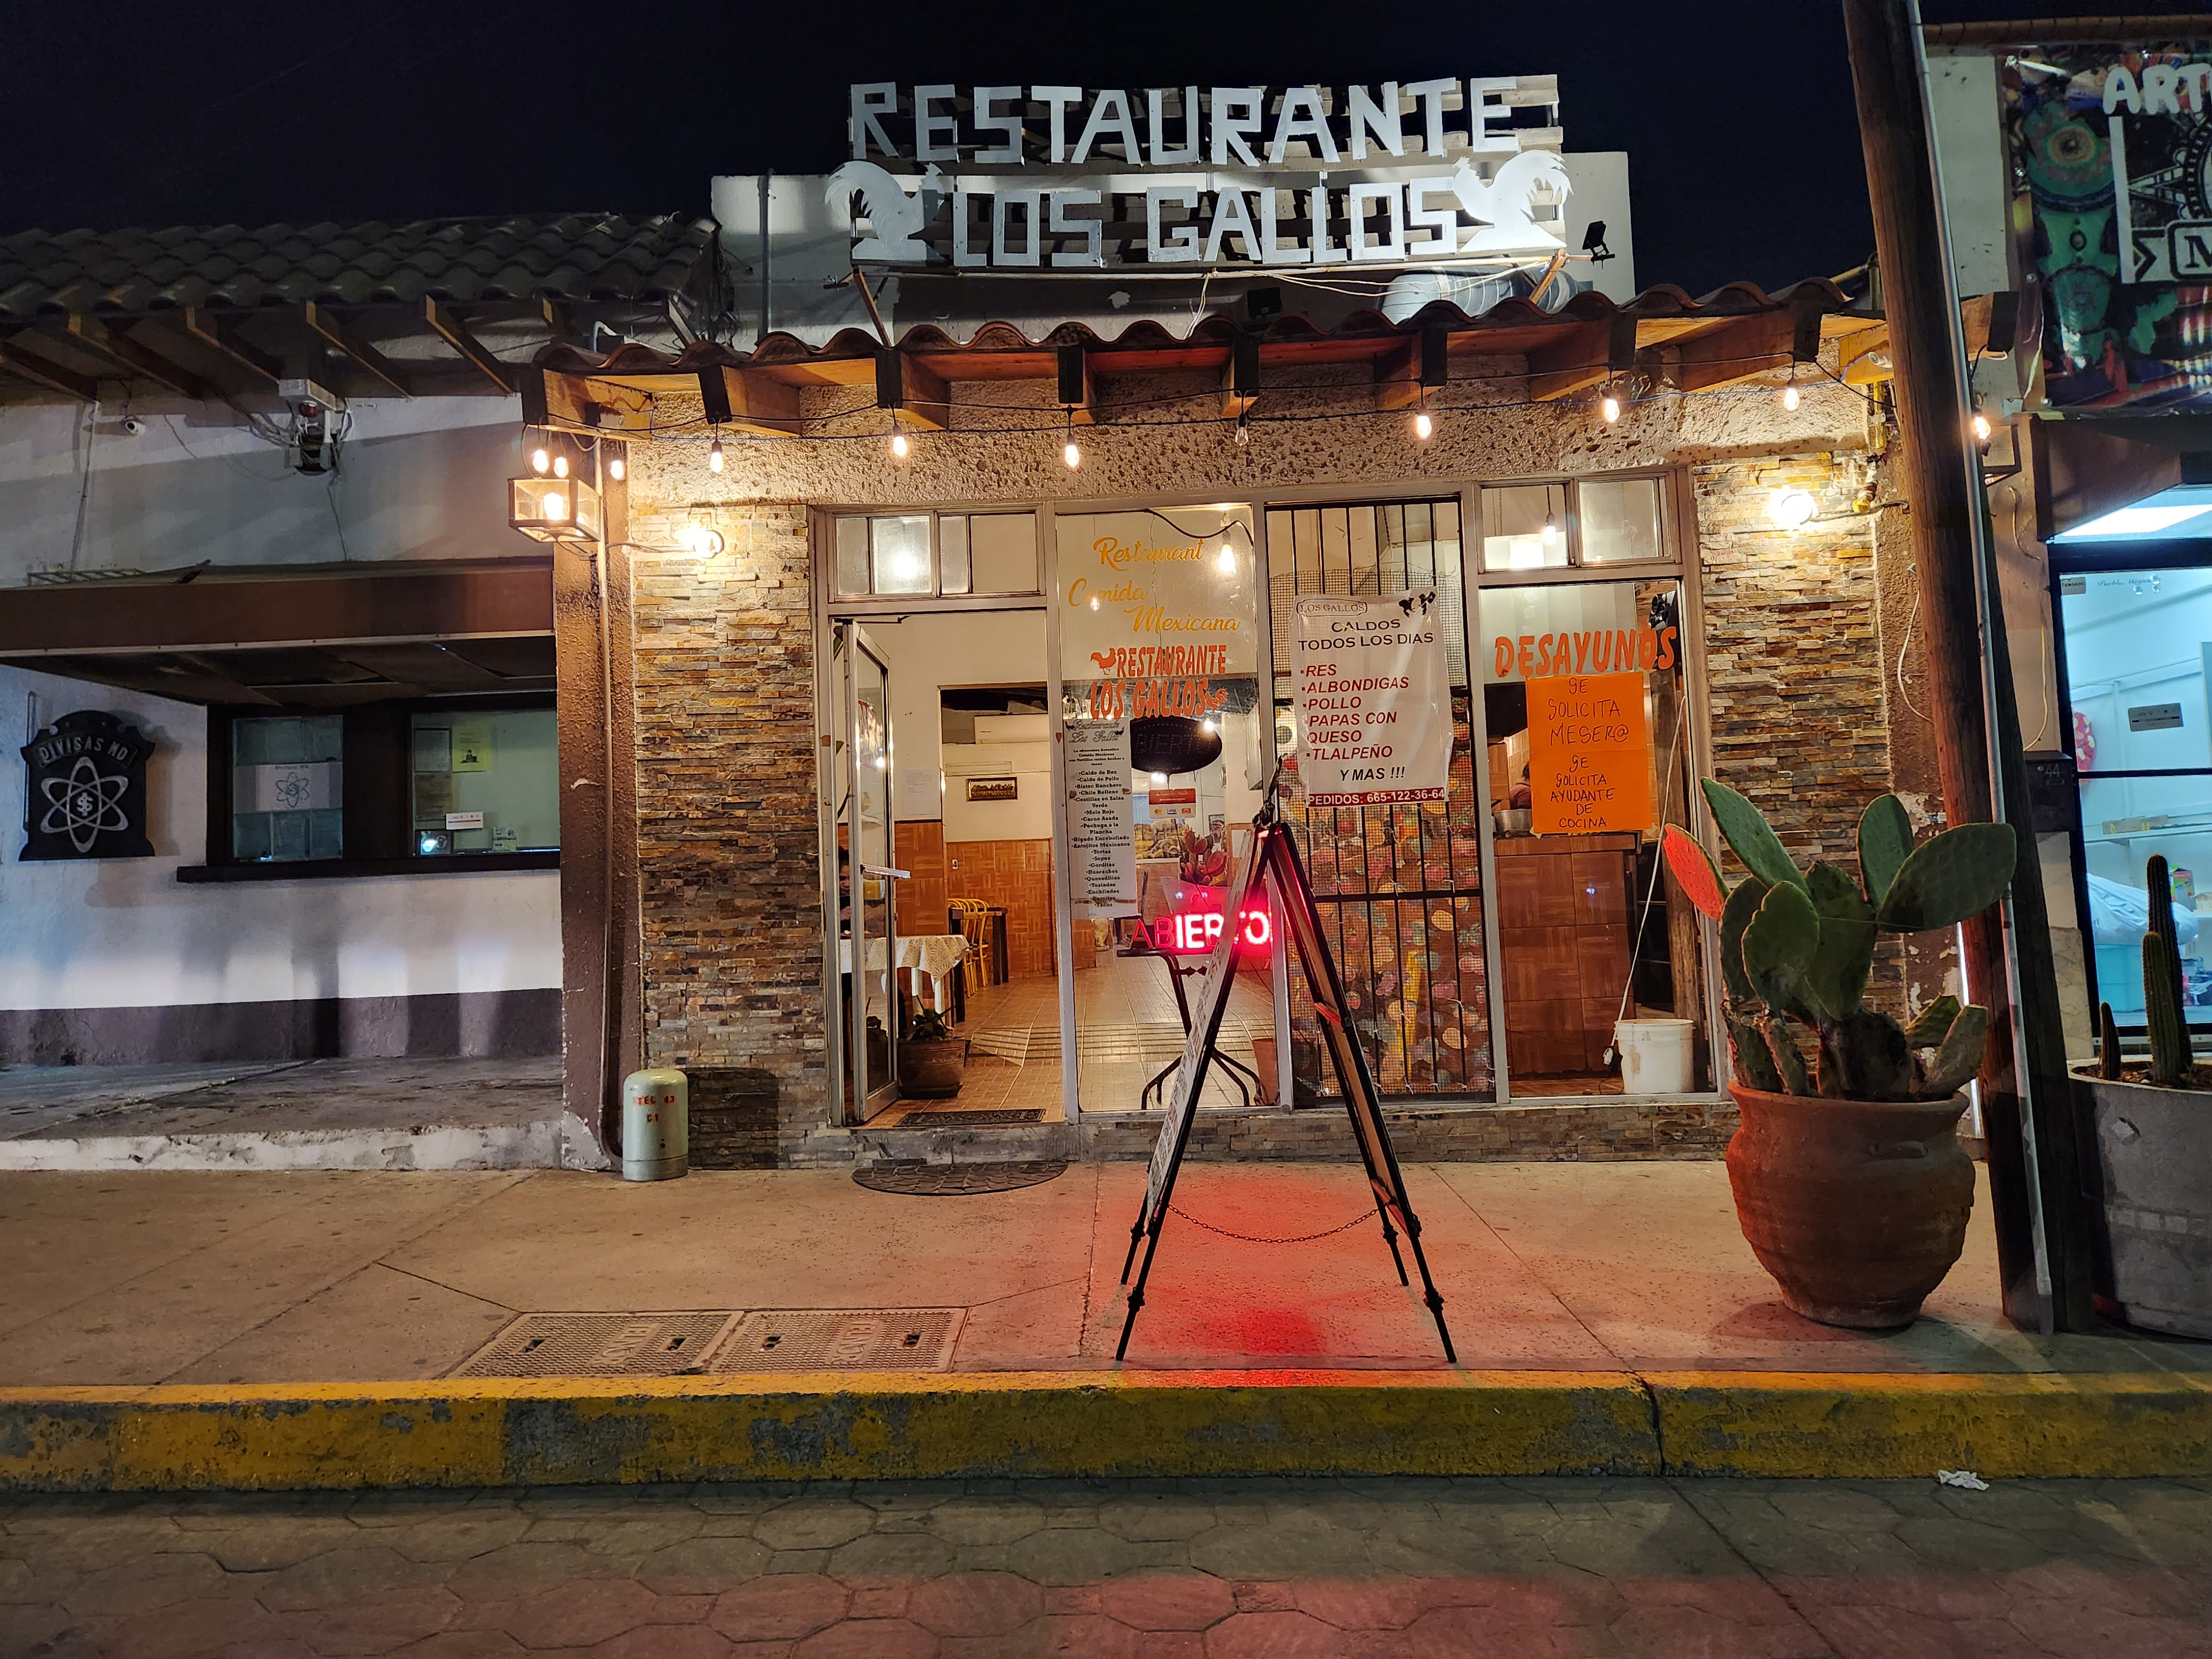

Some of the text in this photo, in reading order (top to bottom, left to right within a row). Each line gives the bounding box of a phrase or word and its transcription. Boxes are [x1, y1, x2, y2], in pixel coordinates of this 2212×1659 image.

[2103, 63, 2212, 114] ART
[850, 77, 1520, 167] RESTAURANTE
[952, 176, 1459, 268] LOS GALLOS
[1093, 537, 1206, 572] Restaurant
[1068, 578, 1148, 607] Comida
[1323, 603, 1365, 612] GALLOS
[1124, 606, 1240, 634] Mexicana
[1331, 619, 1401, 632] CALDOS
[1298, 633, 1434, 651] TODOS LOS DIAS
[1117, 645, 1227, 677] RESTAURANTE
[1495, 627, 1677, 677] DESAYUNOS
[1306, 664, 1337, 677] RES
[1307, 677, 1410, 693] ALBONDIGAS
[1090, 678, 1208, 719] LOS GALLOS
[1308, 697, 1361, 710] POLLO
[1548, 698, 1621, 721] SOLICITA
[1310, 712, 1397, 727] PAPAS CON
[1135, 733, 1212, 754] BIERTO
[1307, 730, 1362, 745] QUESO
[1551, 723, 1629, 745] MESER@
[40, 735, 128, 763] DIVISAS MD
[1340, 769, 1349, 781] Y
[1352, 768, 1385, 781] MAS
[1556, 773, 1608, 787] SOLICITA
[1308, 789, 1445, 805] PEDIDOS: 665-122-36-64
[1550, 788, 1615, 802] AYUDANTE
[1576, 804, 1593, 815] DE
[1559, 817, 1608, 828] COCINA
[1129, 911, 1270, 949] ABIERO
